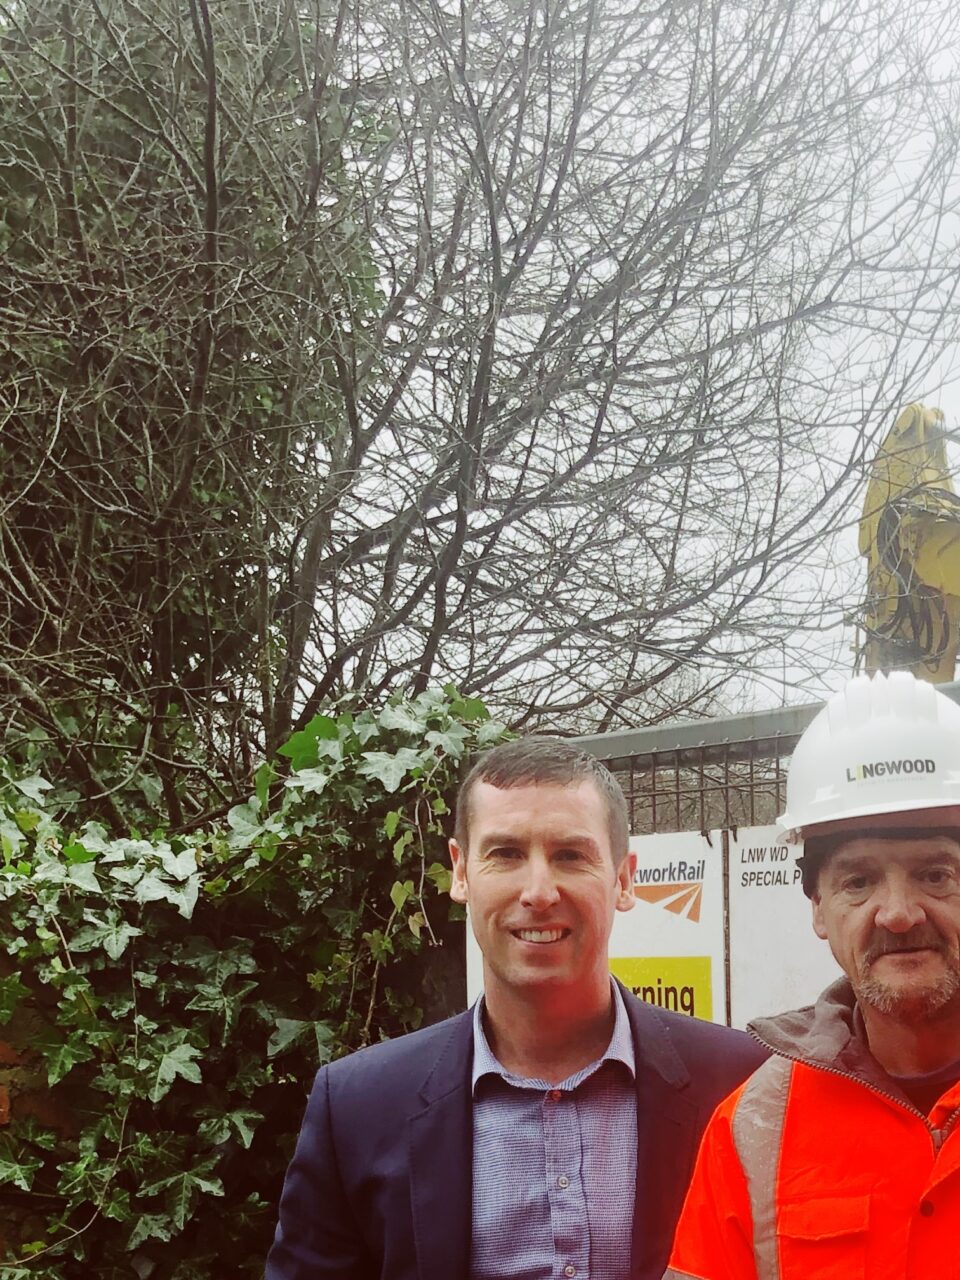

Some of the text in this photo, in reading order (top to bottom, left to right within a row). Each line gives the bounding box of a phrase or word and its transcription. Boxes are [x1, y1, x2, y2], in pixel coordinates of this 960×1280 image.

[741, 846, 789, 863] LNW WD
[741, 869, 790, 887] SPECIAL
